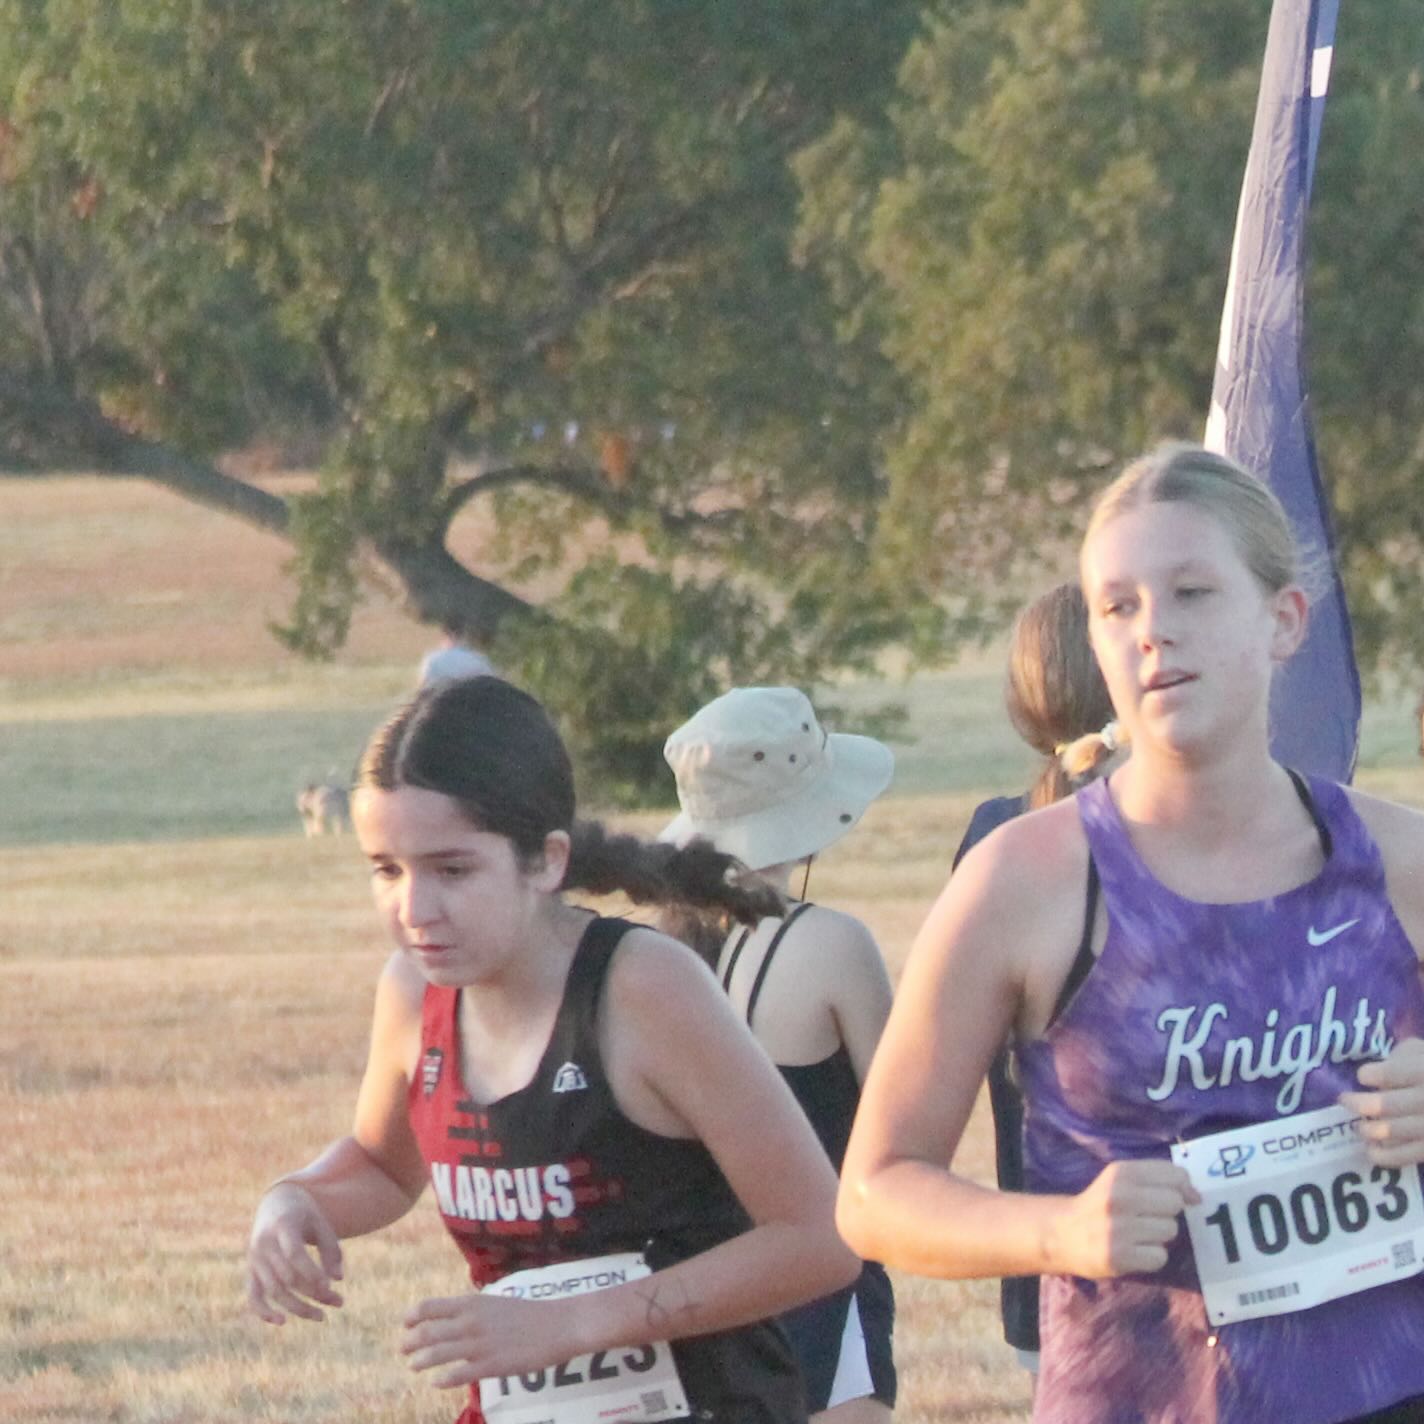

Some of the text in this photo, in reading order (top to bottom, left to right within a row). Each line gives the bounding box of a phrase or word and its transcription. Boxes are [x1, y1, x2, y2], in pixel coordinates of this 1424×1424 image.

[1147, 986, 1394, 1114] Knights
[1262, 1117, 1362, 1155] COMPT
[431, 1161, 577, 1222] MARCUS
[1205, 1166, 1409, 1264] 10063
[530, 1269, 627, 1299] COMPTON
